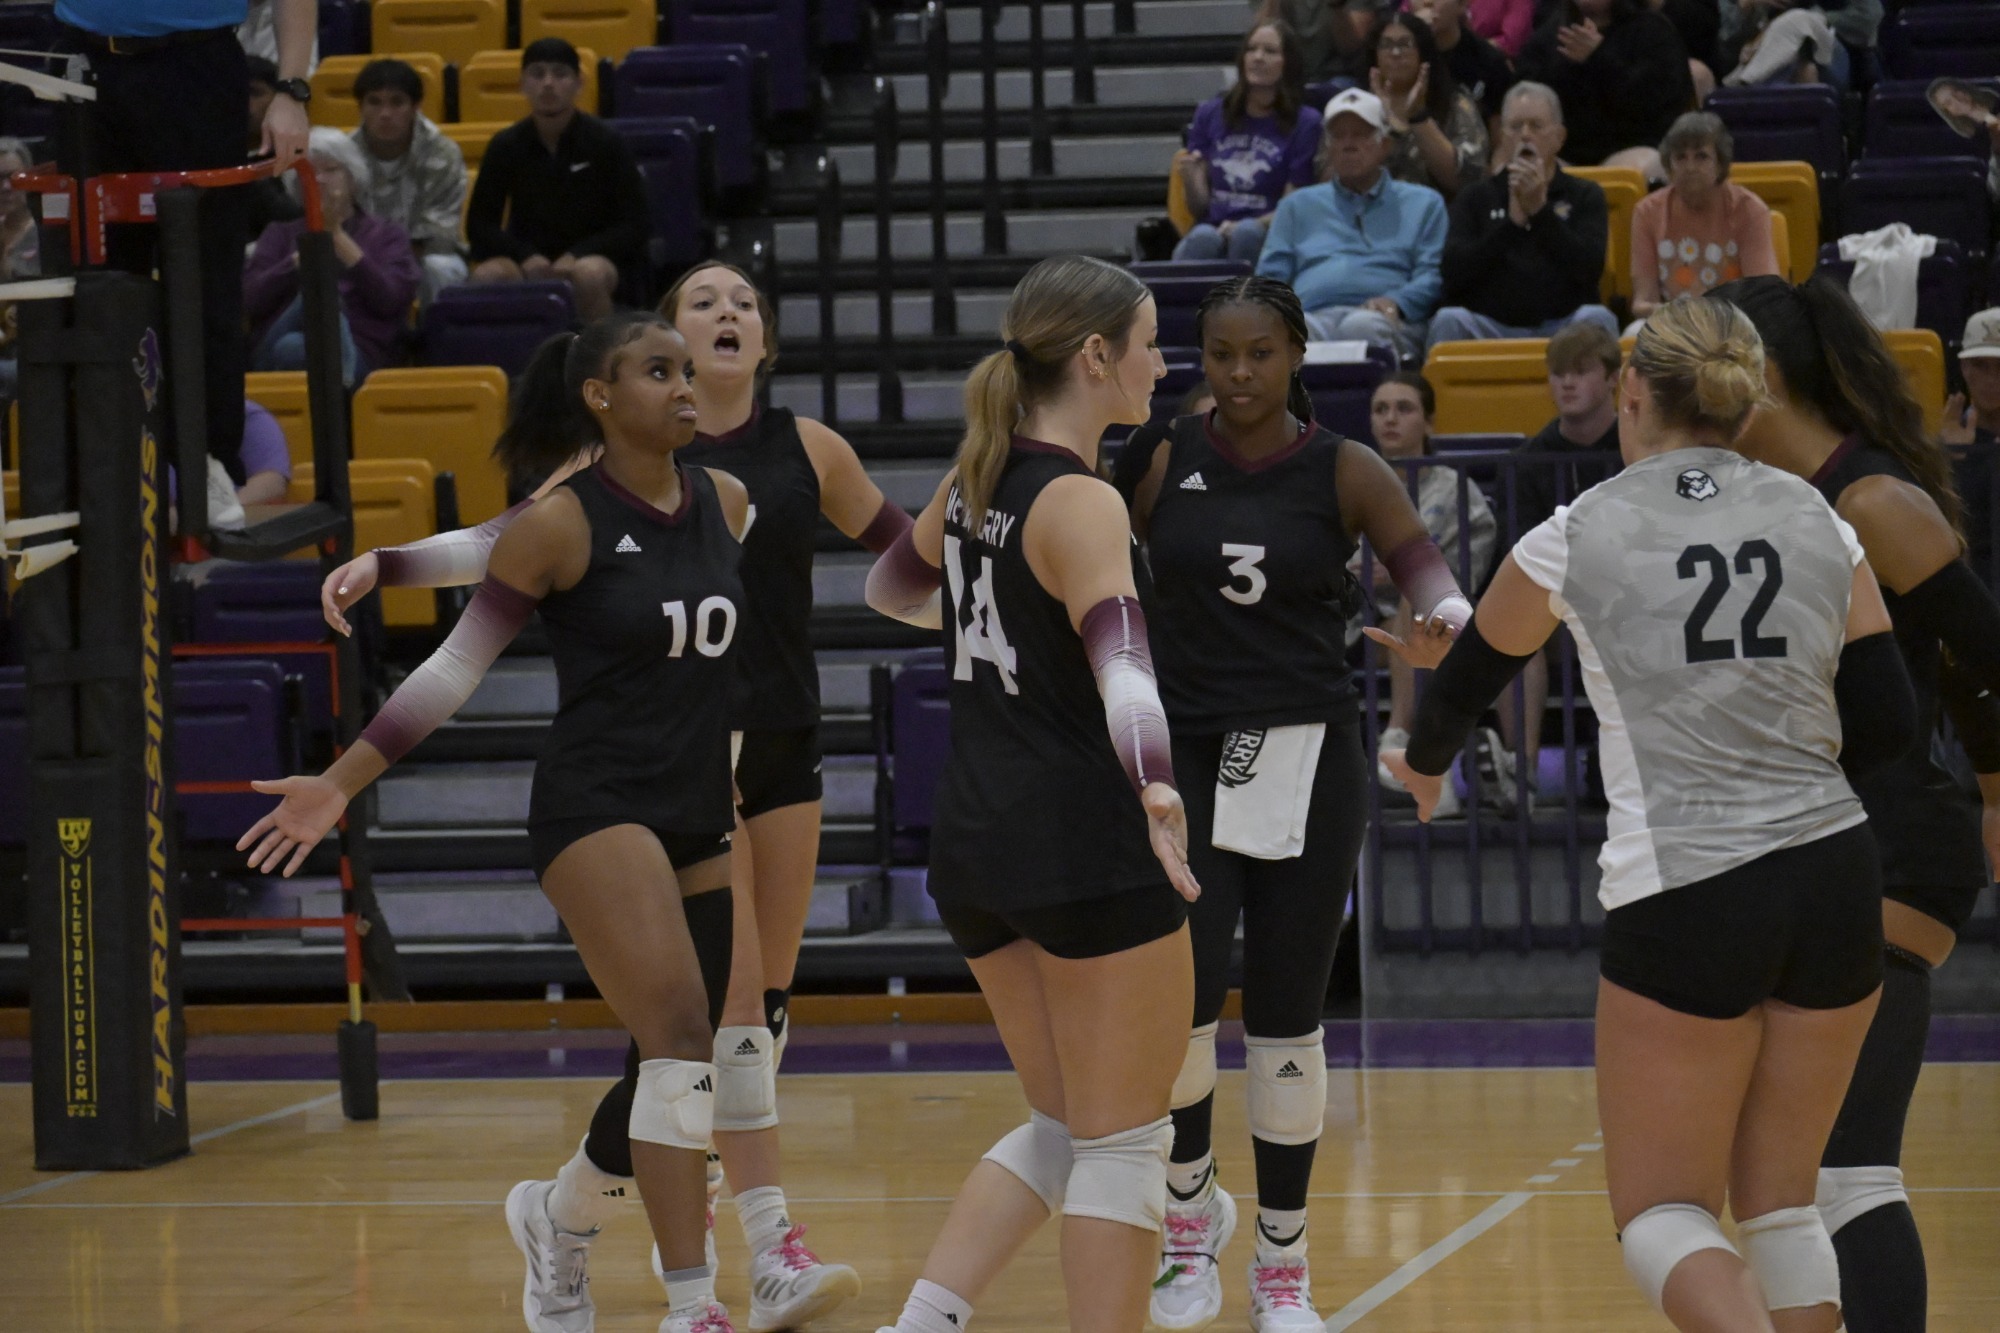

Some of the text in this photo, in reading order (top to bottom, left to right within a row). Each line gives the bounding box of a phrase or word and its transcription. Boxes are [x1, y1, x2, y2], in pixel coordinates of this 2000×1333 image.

[1180, 482, 1207, 490] adidas
[615, 545, 642, 553] adidas
[1219, 543, 1267, 605] 3
[662, 595, 737, 658] 10
[944, 533, 1019, 695] 14
[1676, 539, 1787, 664] 22
[140, 432, 174, 1112] HARDIN-SIMMONS
[734, 1048, 759, 1056] adidas
